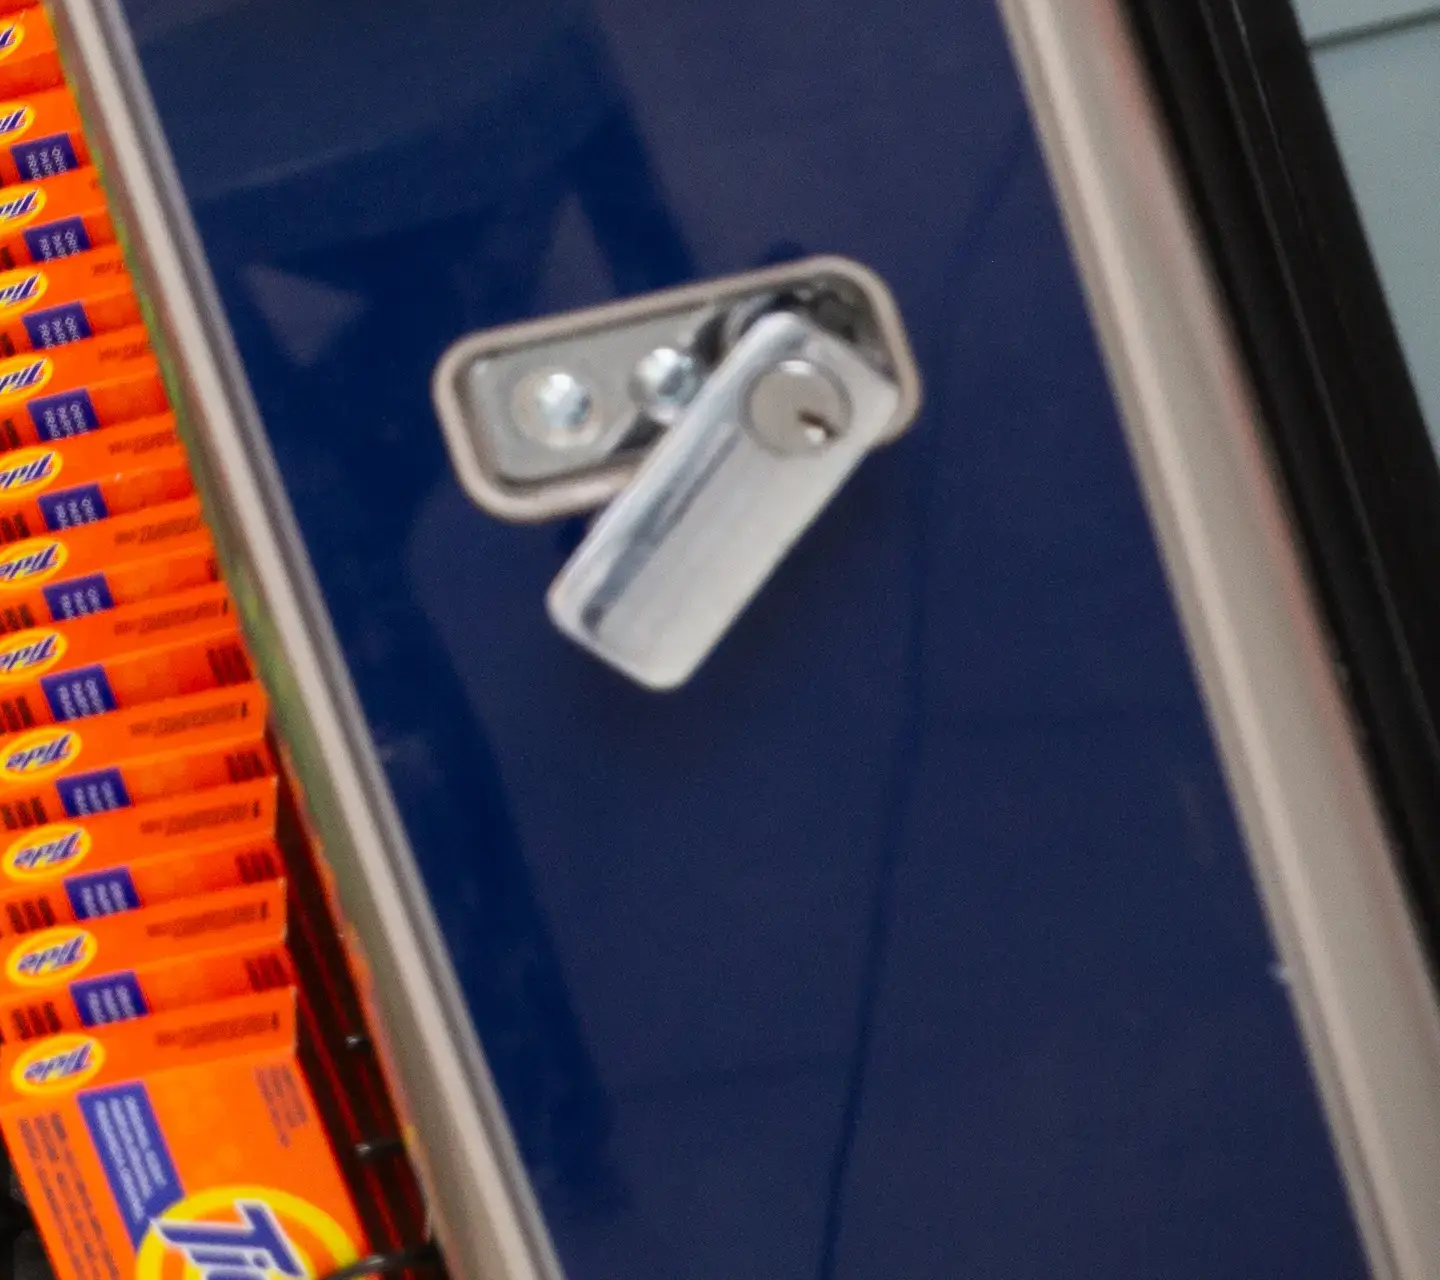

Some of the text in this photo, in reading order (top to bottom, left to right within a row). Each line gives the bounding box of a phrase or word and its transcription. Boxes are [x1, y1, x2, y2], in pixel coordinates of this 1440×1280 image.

[5, 733, 75, 771] Tide
[14, 828, 84, 866] Tide
[17, 932, 86, 973] Tide
[23, 1039, 93, 1081] Tide
[151, 1199, 304, 1280] Ti
